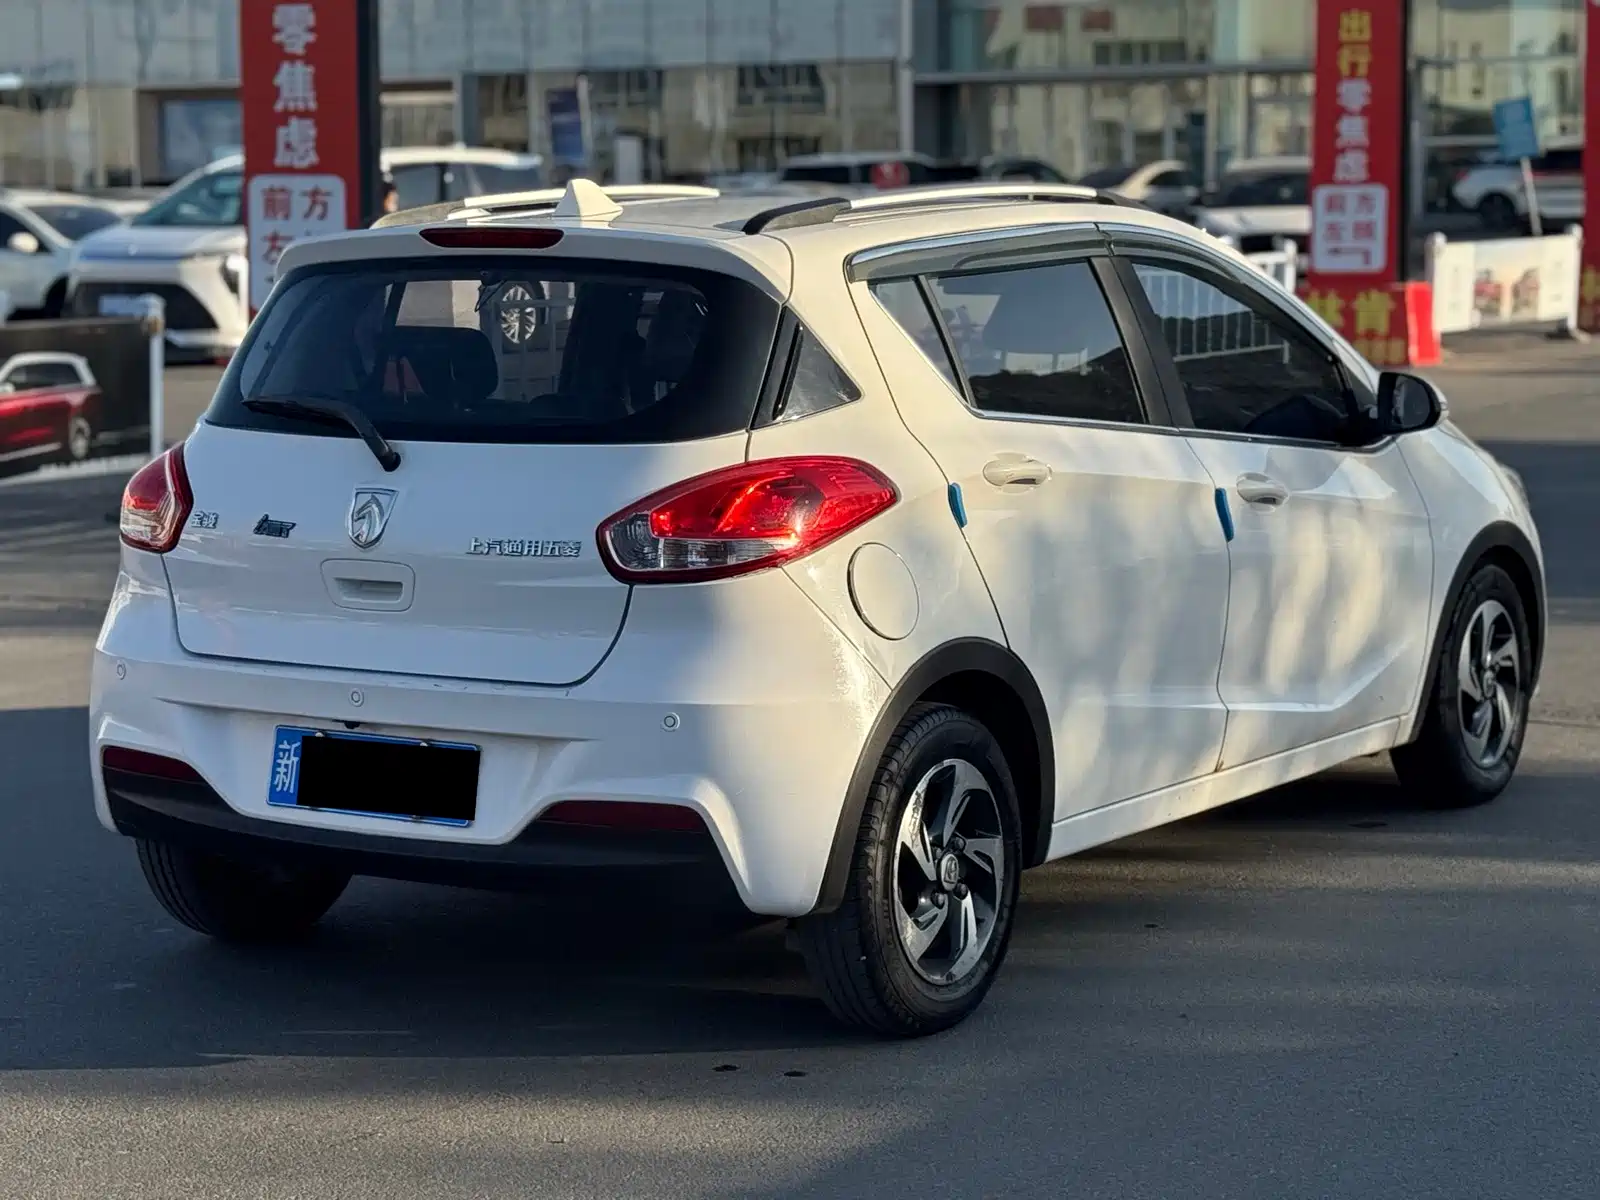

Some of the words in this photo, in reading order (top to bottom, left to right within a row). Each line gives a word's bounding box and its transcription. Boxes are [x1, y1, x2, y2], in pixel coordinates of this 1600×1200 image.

[272, 3, 319, 168] 零焦虑
[261, 186, 334, 220] 前方
[466, 537, 581, 557] 上汽通用五菱
[273, 739, 301, 794] 新
